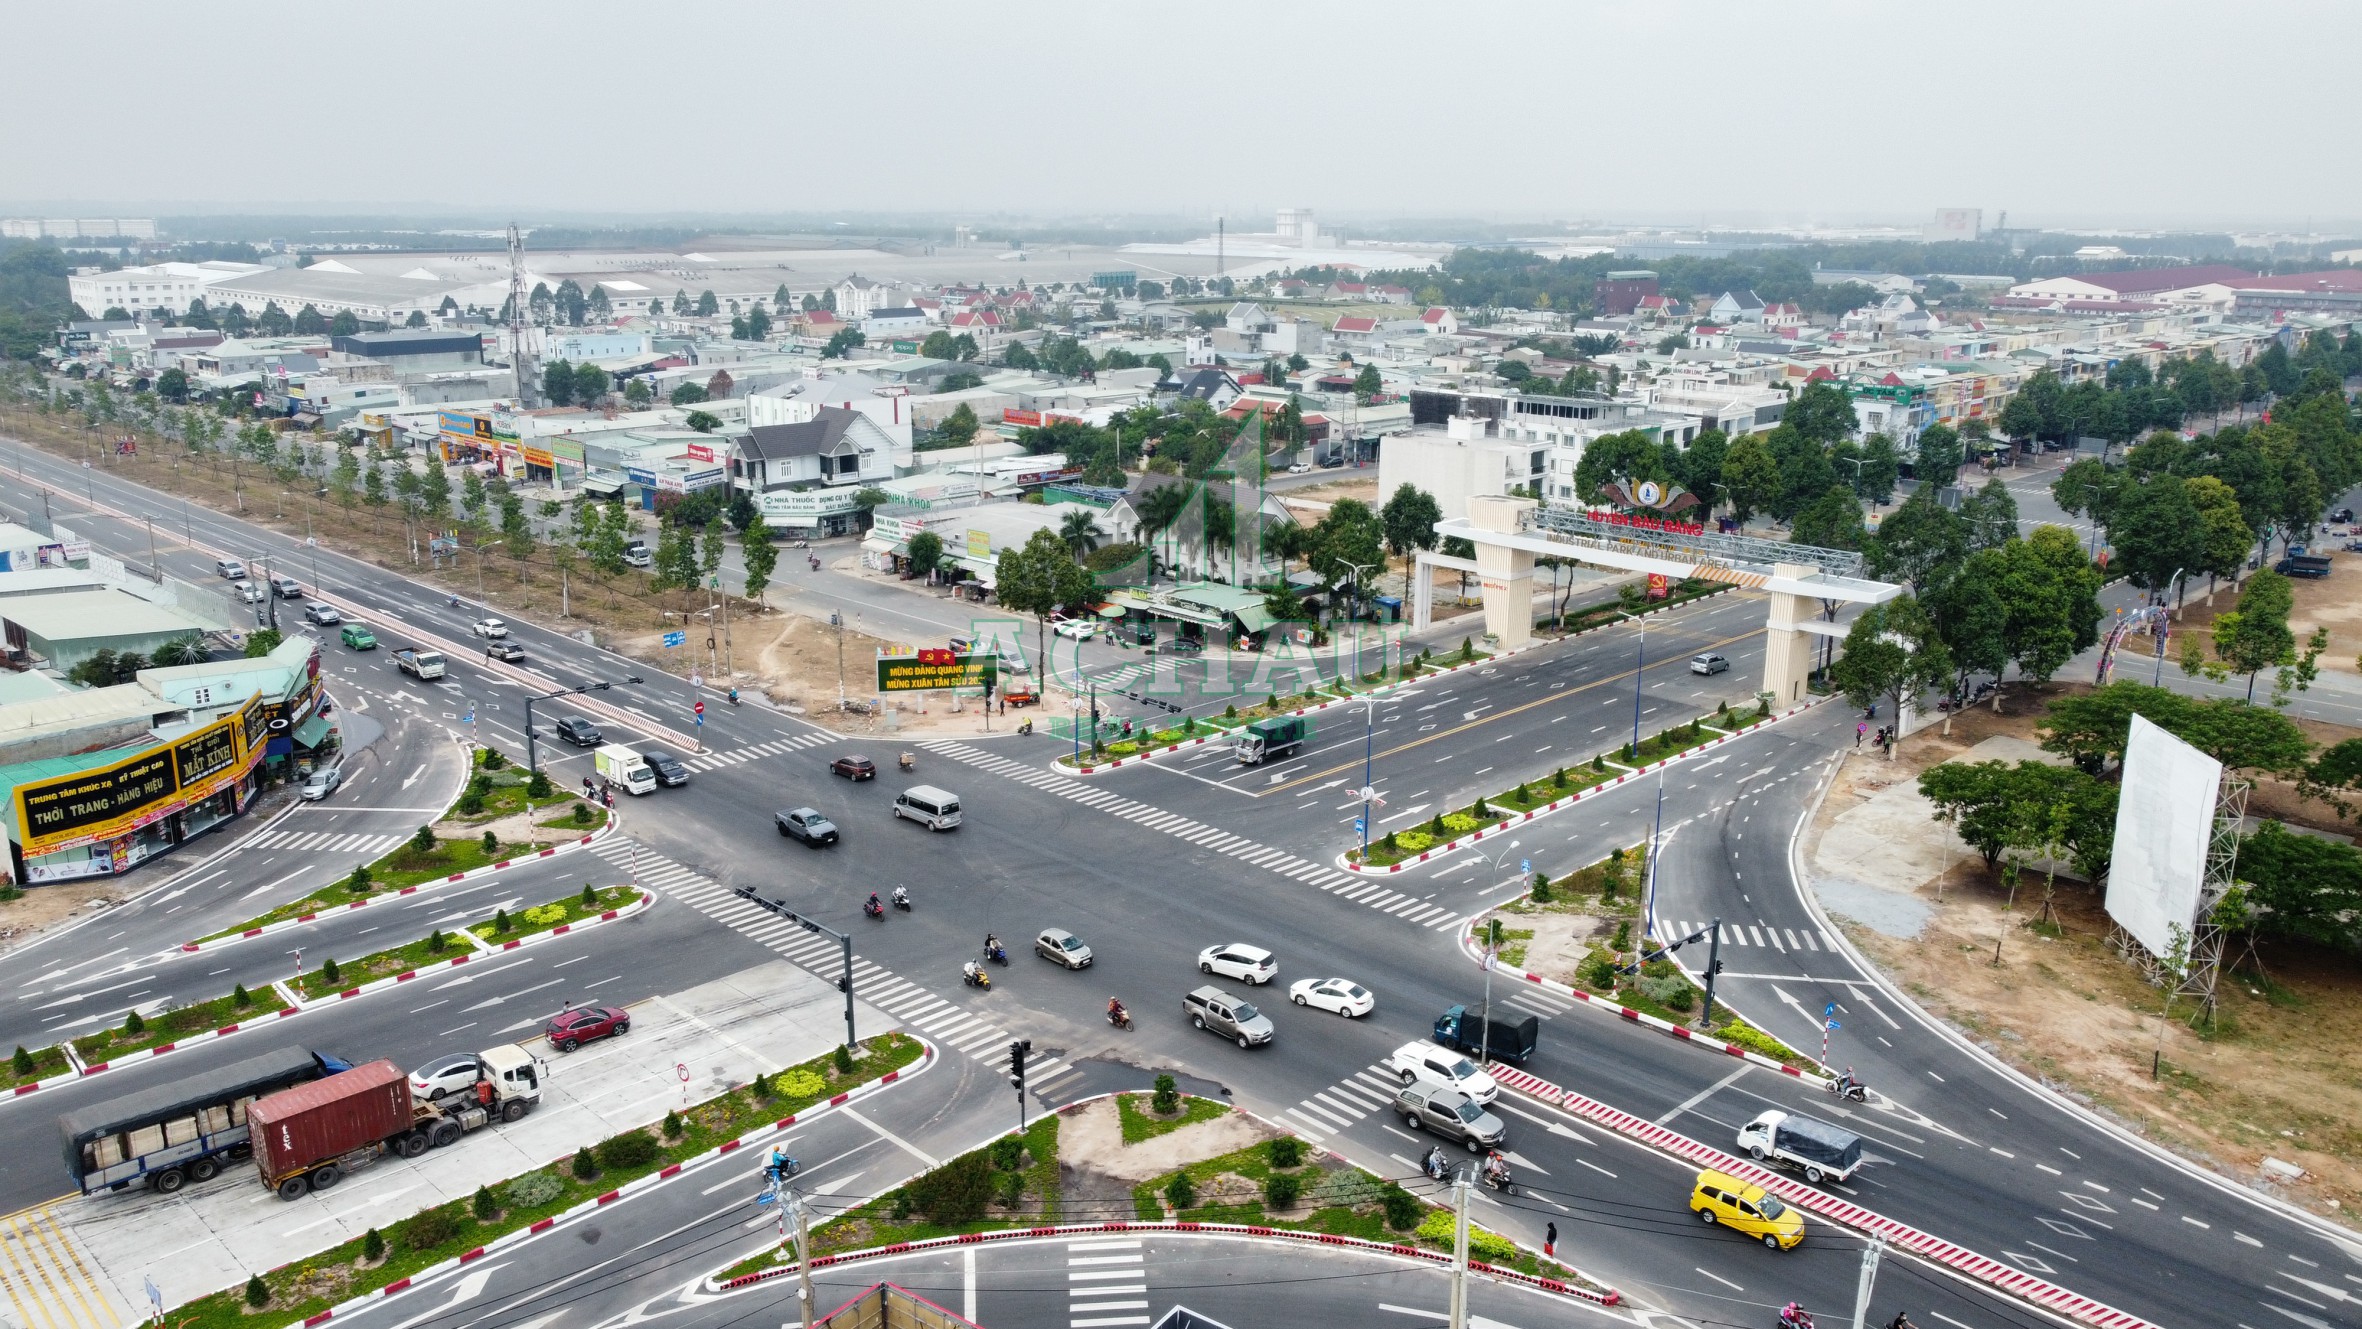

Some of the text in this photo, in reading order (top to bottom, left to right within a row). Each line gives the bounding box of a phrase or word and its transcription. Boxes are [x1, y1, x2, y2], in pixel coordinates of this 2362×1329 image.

[909, 498, 931, 510] KHOA
[1546, 534, 1600, 550] INDUSTRIAL
[1606, 544, 1632, 556] PARK
[1636, 547, 1659, 560] AND
[1660, 550, 1696, 566] URBAN
[1698, 558, 1730, 571] AREA
[886, 678, 911, 689] MỪNG
[912, 677, 933, 688] XUÂN
[934, 676, 949, 687] TÂN
[950, 674, 967, 686] SỬU
[890, 664, 983, 676] MỪNG ĐẢNG QUANG VINH
[184, 754, 204, 778] MẮT
[206, 745, 231, 767] KÍNH
[28, 793, 58, 805] TRUNG
[58, 788, 77, 798] TÂM
[78, 780, 100, 794] KHÚC
[101, 780, 112, 789] XẠ
[130, 766, 149, 779] THUẬT
[151, 760, 164, 770] CAO
[35, 804, 64, 825] THỜI
[69, 798, 109, 817] TRANG
[117, 786, 141, 805] HÀNG
[144, 777, 164, 794] HIỆU
[282, 1124, 292, 1152] tex
